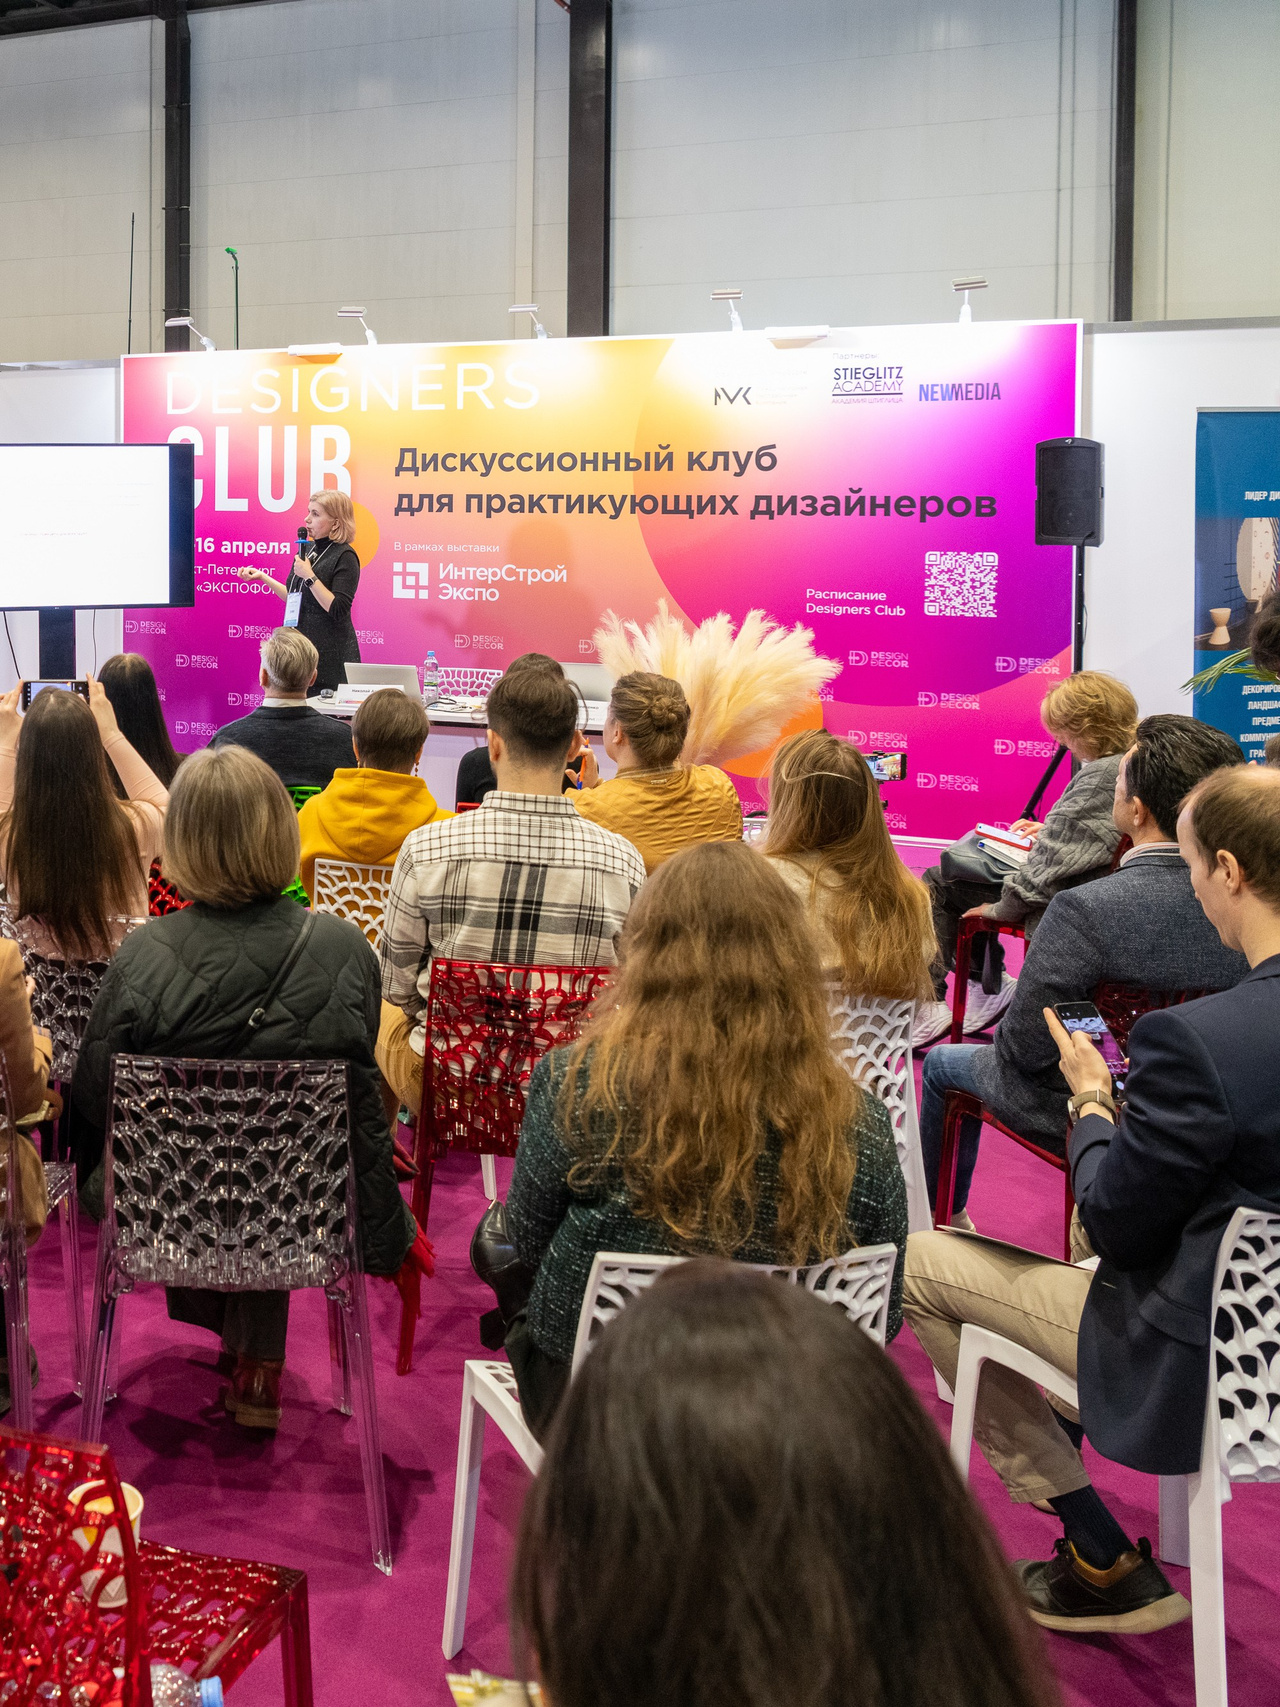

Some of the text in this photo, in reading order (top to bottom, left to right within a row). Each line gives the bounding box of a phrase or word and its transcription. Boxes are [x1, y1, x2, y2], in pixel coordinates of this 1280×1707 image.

[833, 366, 903, 380] STIEGLITZ
[166, 361, 541, 416] DESIGNERS
[831, 380, 904, 393] ACADEMY
[394, 443, 778, 478] Дискуссионный клуб
[1244, 491, 1268, 501] ЛИДЕР
[394, 487, 998, 523] для практикующих дизайнеров
[220, 540, 291, 557] апреля
[393, 541, 500, 553] В рамках выставки
[439, 562, 568, 586] ИнтерСтрой
[196, 581, 275, 595] «ЭКСПОФО
[438, 582, 500, 602] Экспо
[806, 588, 887, 601] Расписание
[806, 602, 906, 616] Designers Club
[140, 620, 167, 629] DESIGN
[472, 634, 504, 643] DESIGN
[191, 654, 218, 662] DESIGN
[870, 651, 909, 661] DESIGN
[1019, 657, 1060, 667] DESIGN
[870, 658, 909, 668] DECOR
[939, 692, 980, 702] DESIGN
[190, 722, 218, 730] DESIGN
[870, 731, 908, 741] DESIGN
[939, 775, 979, 785] DESIGN
